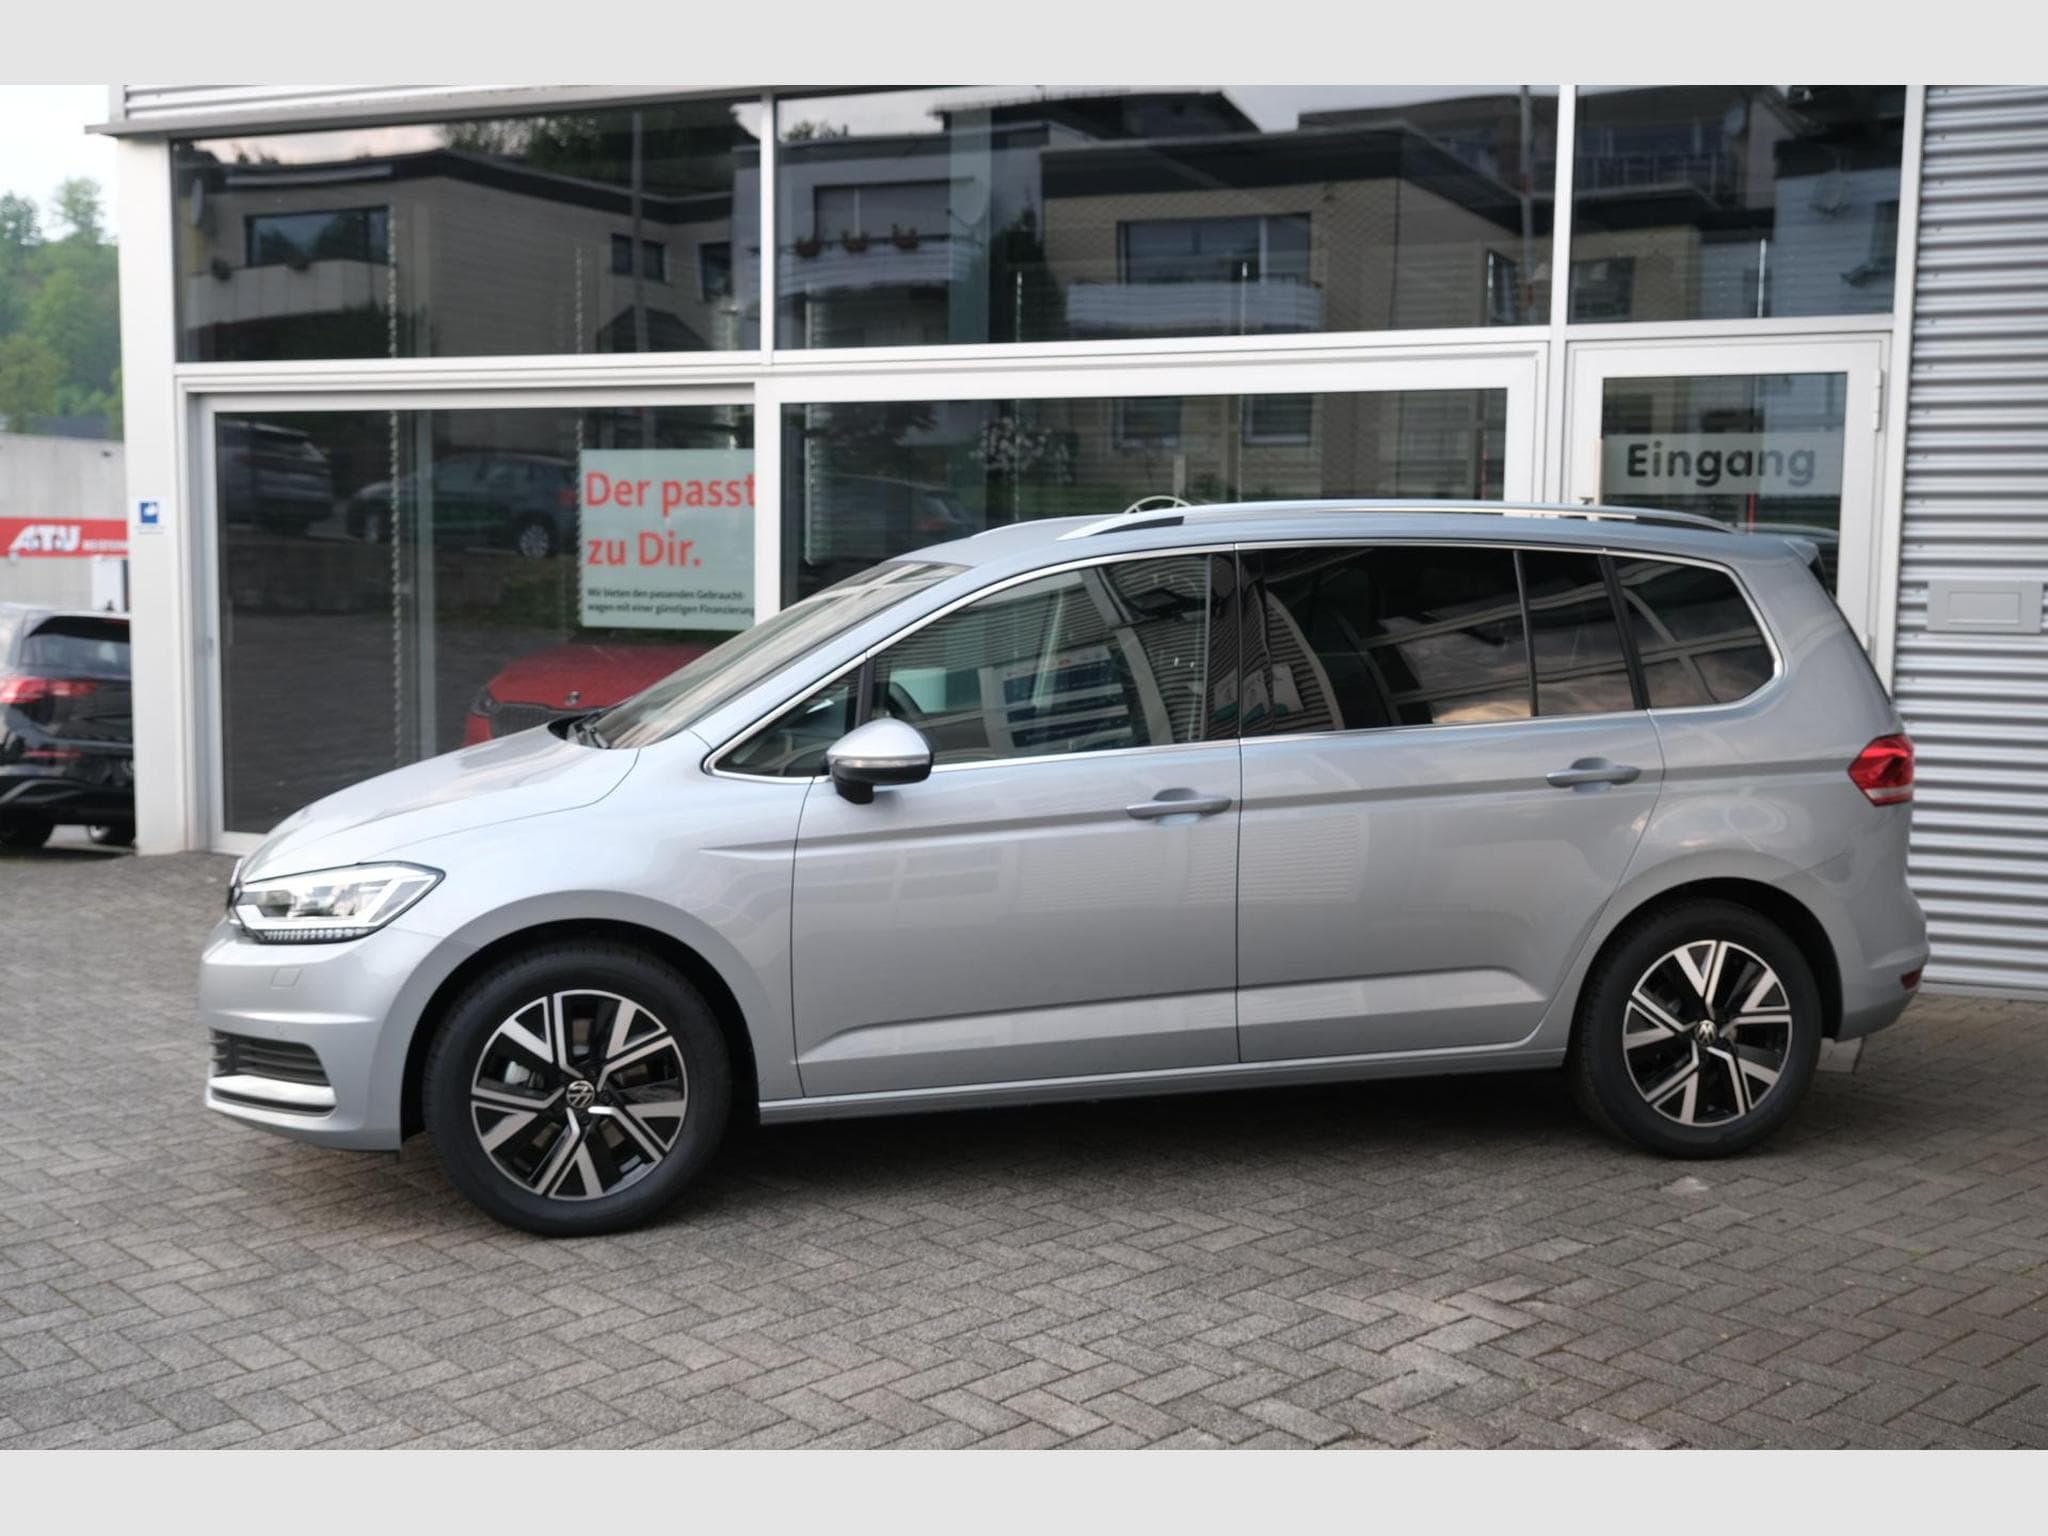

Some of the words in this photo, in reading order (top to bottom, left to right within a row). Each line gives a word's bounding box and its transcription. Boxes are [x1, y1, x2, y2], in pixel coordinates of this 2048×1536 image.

[1626, 440, 1816, 487] Eingang
[586, 471, 650, 507] Der
[661, 473, 755, 518] passt
[587, 539, 626, 566] zu
[638, 530, 702, 567] Dir.
[588, 604, 614, 615] wagen
[616, 603, 630, 612] mit
[632, 604, 653, 613] einer
[604, 587, 630, 598] bieten
[632, 589, 647, 598] den
